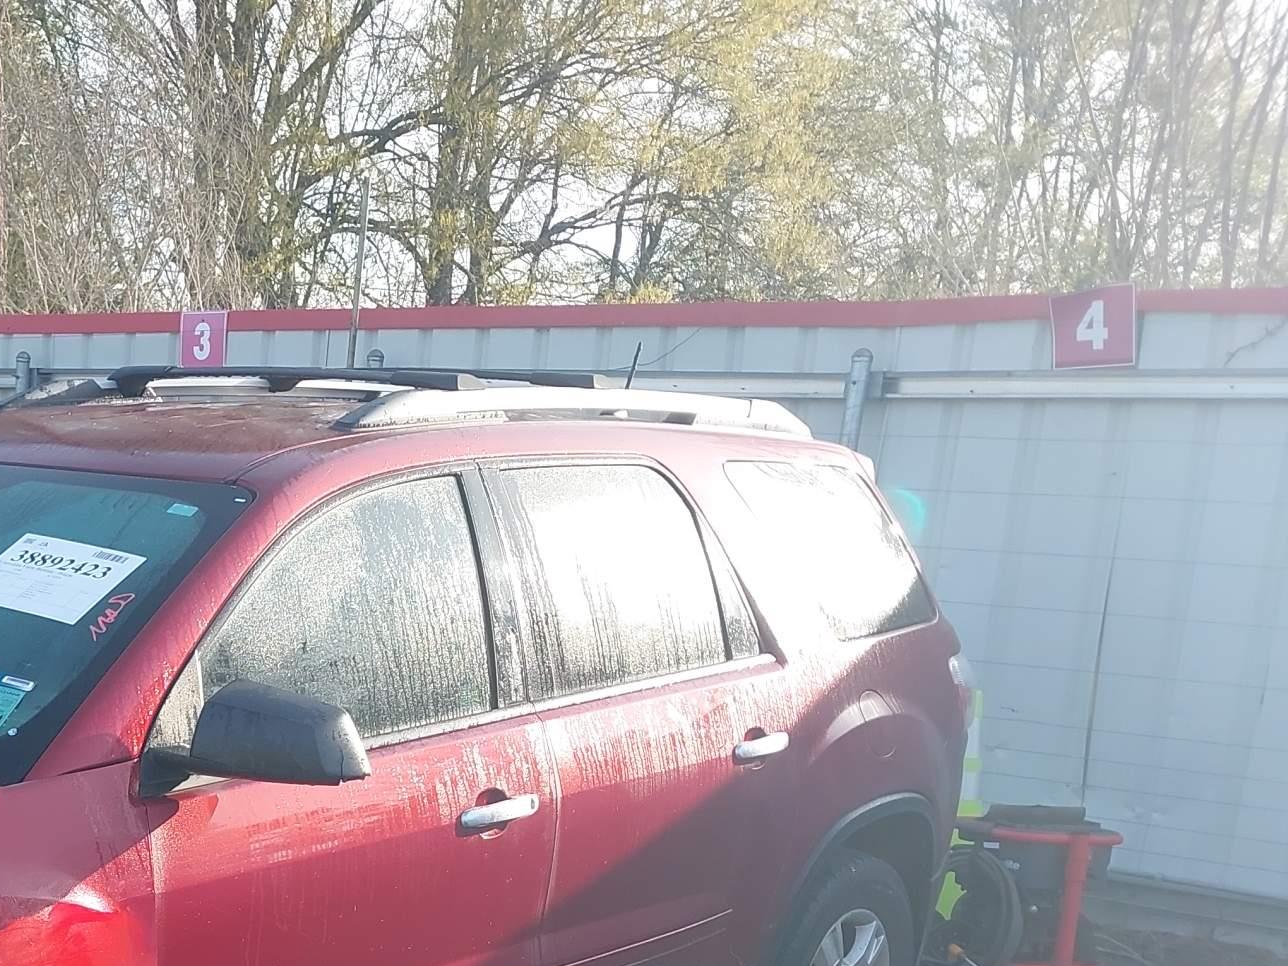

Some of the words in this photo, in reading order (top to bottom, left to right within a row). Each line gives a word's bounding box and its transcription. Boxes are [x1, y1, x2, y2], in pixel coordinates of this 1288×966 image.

[193, 322, 211, 361] 3
[1076, 299, 1108, 350] 4
[10, 549, 112, 580] 38892423
